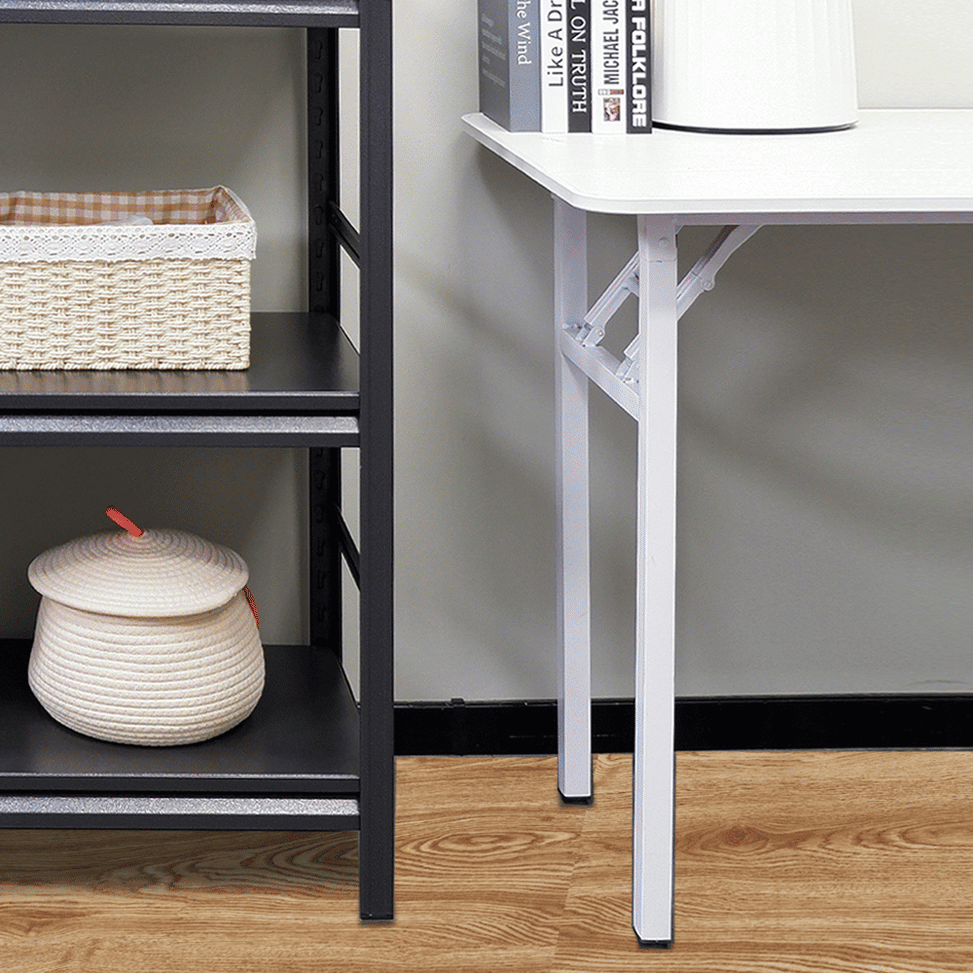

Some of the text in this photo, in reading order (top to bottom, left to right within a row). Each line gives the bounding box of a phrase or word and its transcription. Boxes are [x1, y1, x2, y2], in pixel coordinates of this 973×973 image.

[517, 22, 530, 65] Wind
[548, 29, 562, 41] A
[571, 16, 585, 43] ON
[548, 46, 563, 87] Like
[603, 29, 620, 85] MICHAEL
[631, 17, 647, 128] FOLKLORE
[572, 50, 587, 113] TRUTH
